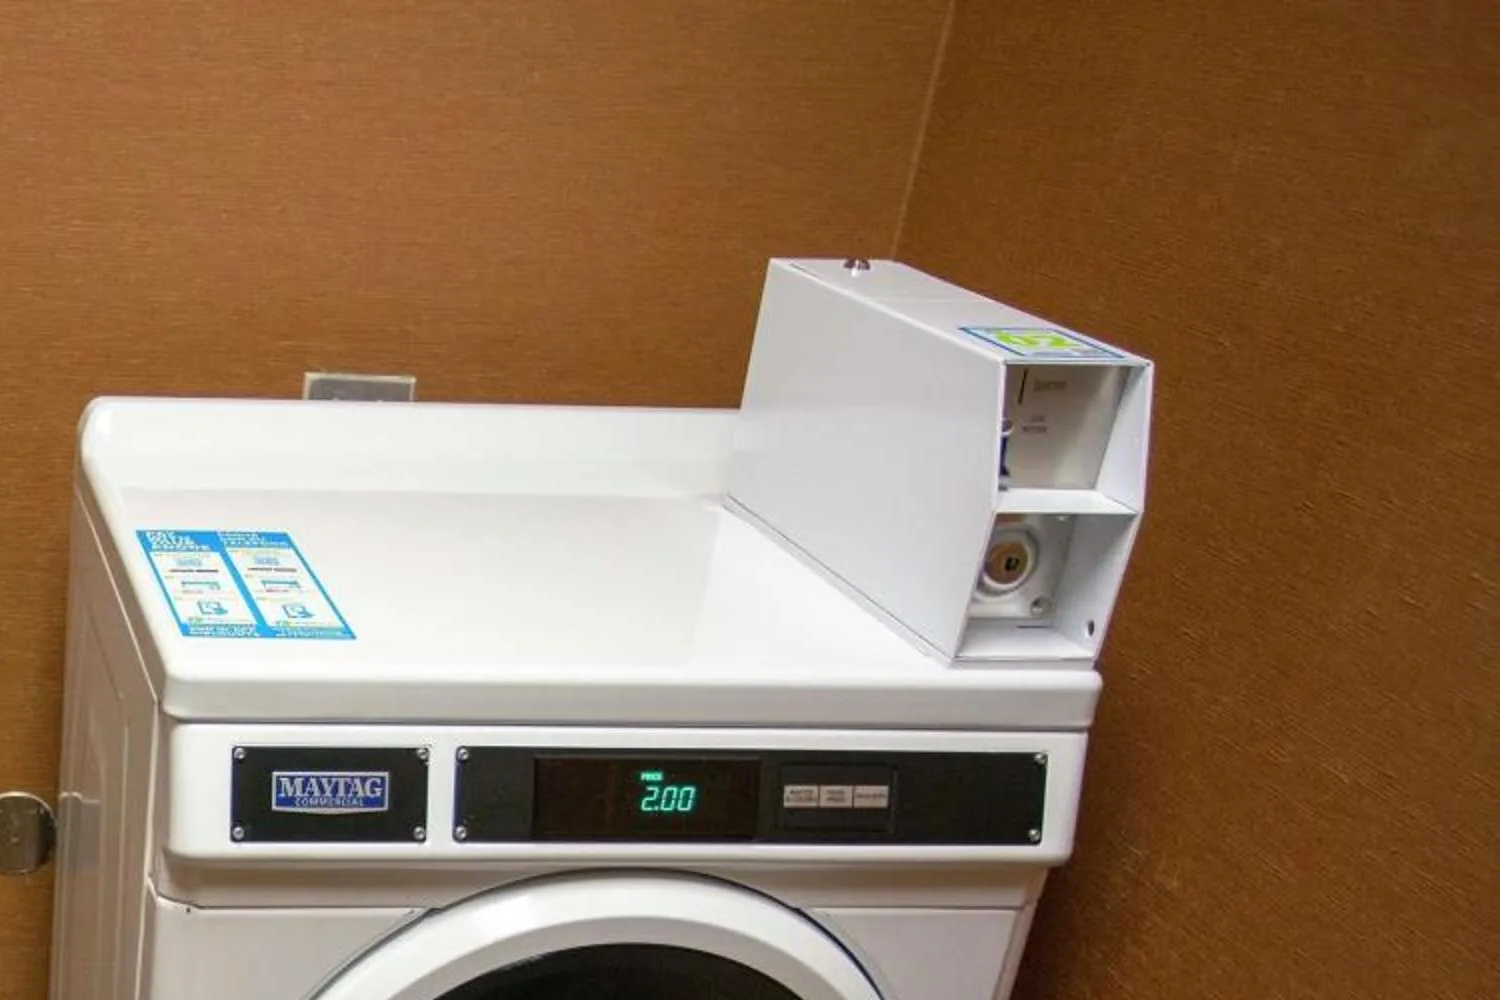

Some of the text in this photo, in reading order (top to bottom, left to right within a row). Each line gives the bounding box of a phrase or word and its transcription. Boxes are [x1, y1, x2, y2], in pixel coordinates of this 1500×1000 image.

[279, 777, 382, 798] MAYTAG
[294, 797, 365, 807] COMMERCIAL
[640, 786, 697, 812] 2.00
